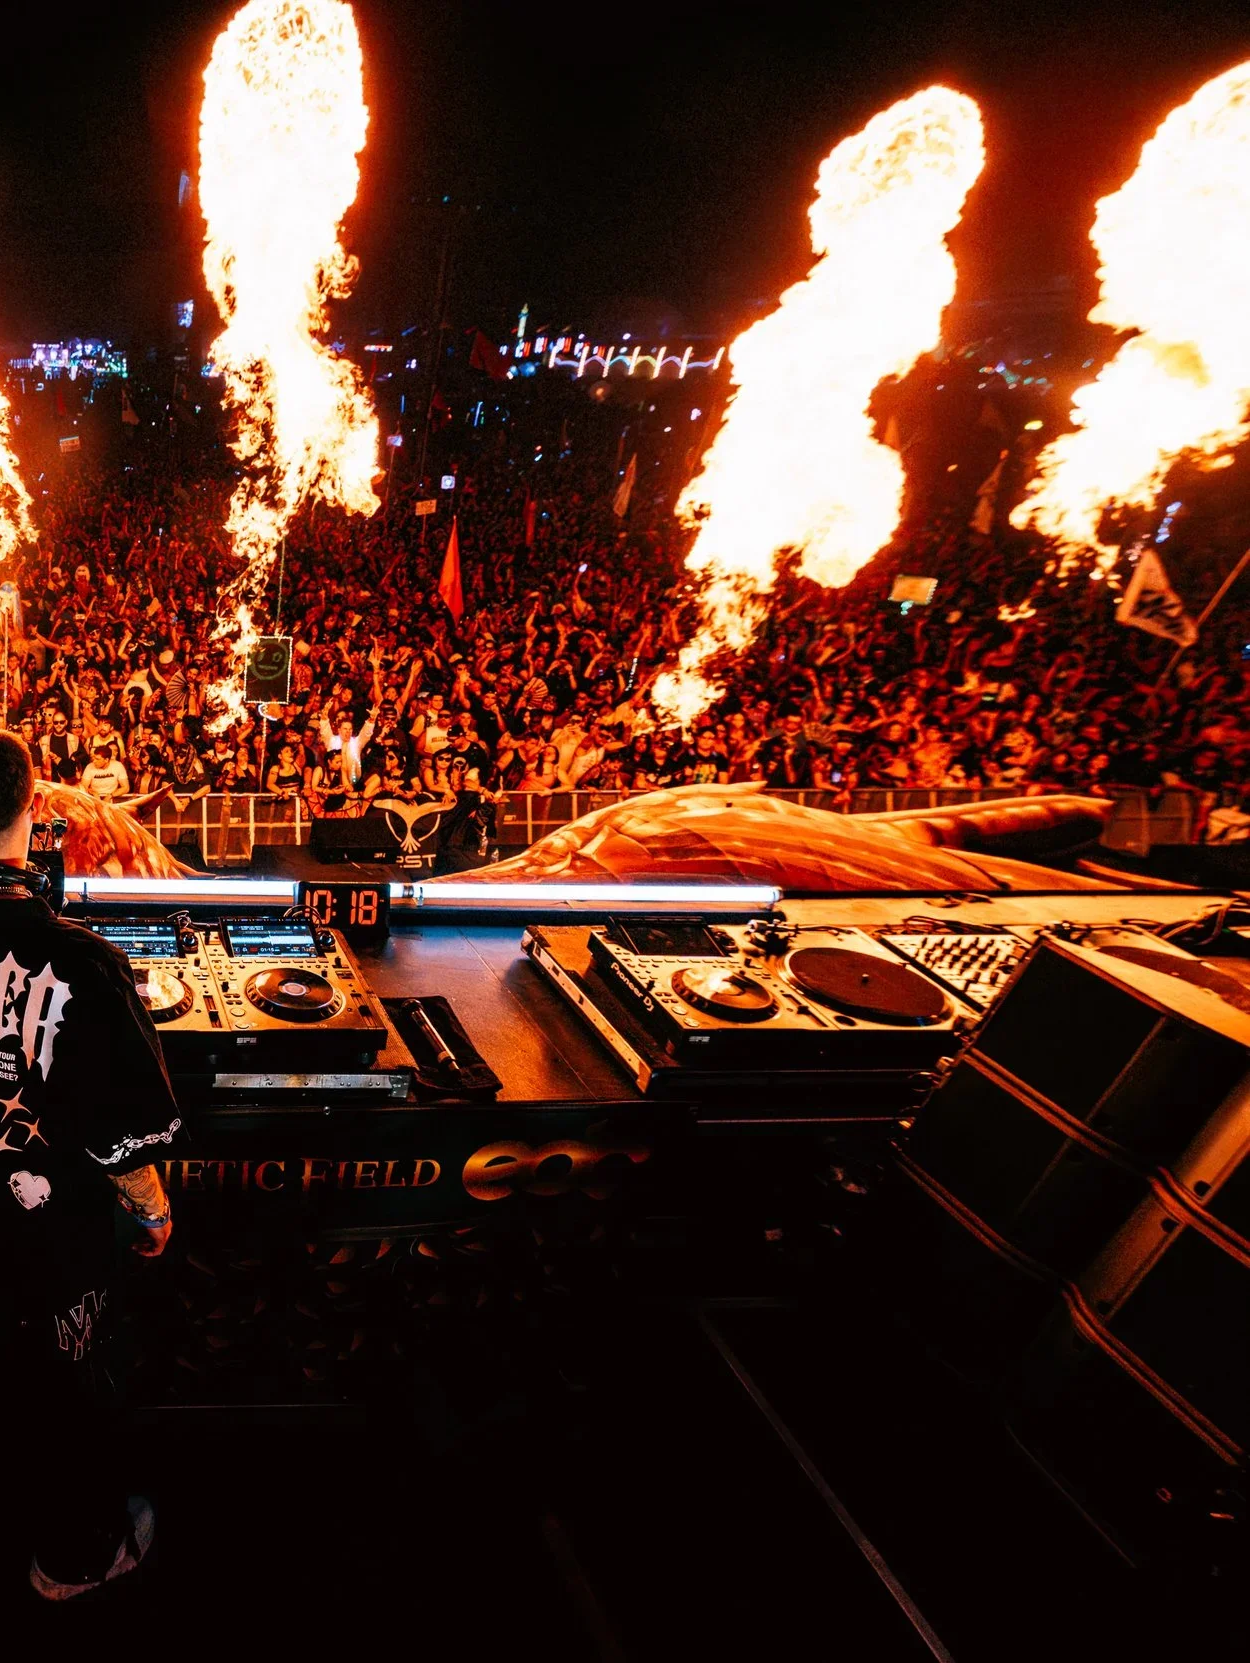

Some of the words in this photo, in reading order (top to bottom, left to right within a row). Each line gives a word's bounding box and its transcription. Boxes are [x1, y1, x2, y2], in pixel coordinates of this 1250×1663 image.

[305, 889, 378, 925] 10:18
[611, 962, 643, 998] Pioneer
[0, 1071, 19, 1082] SEE?
[300, 1155, 442, 1194] FIELD
